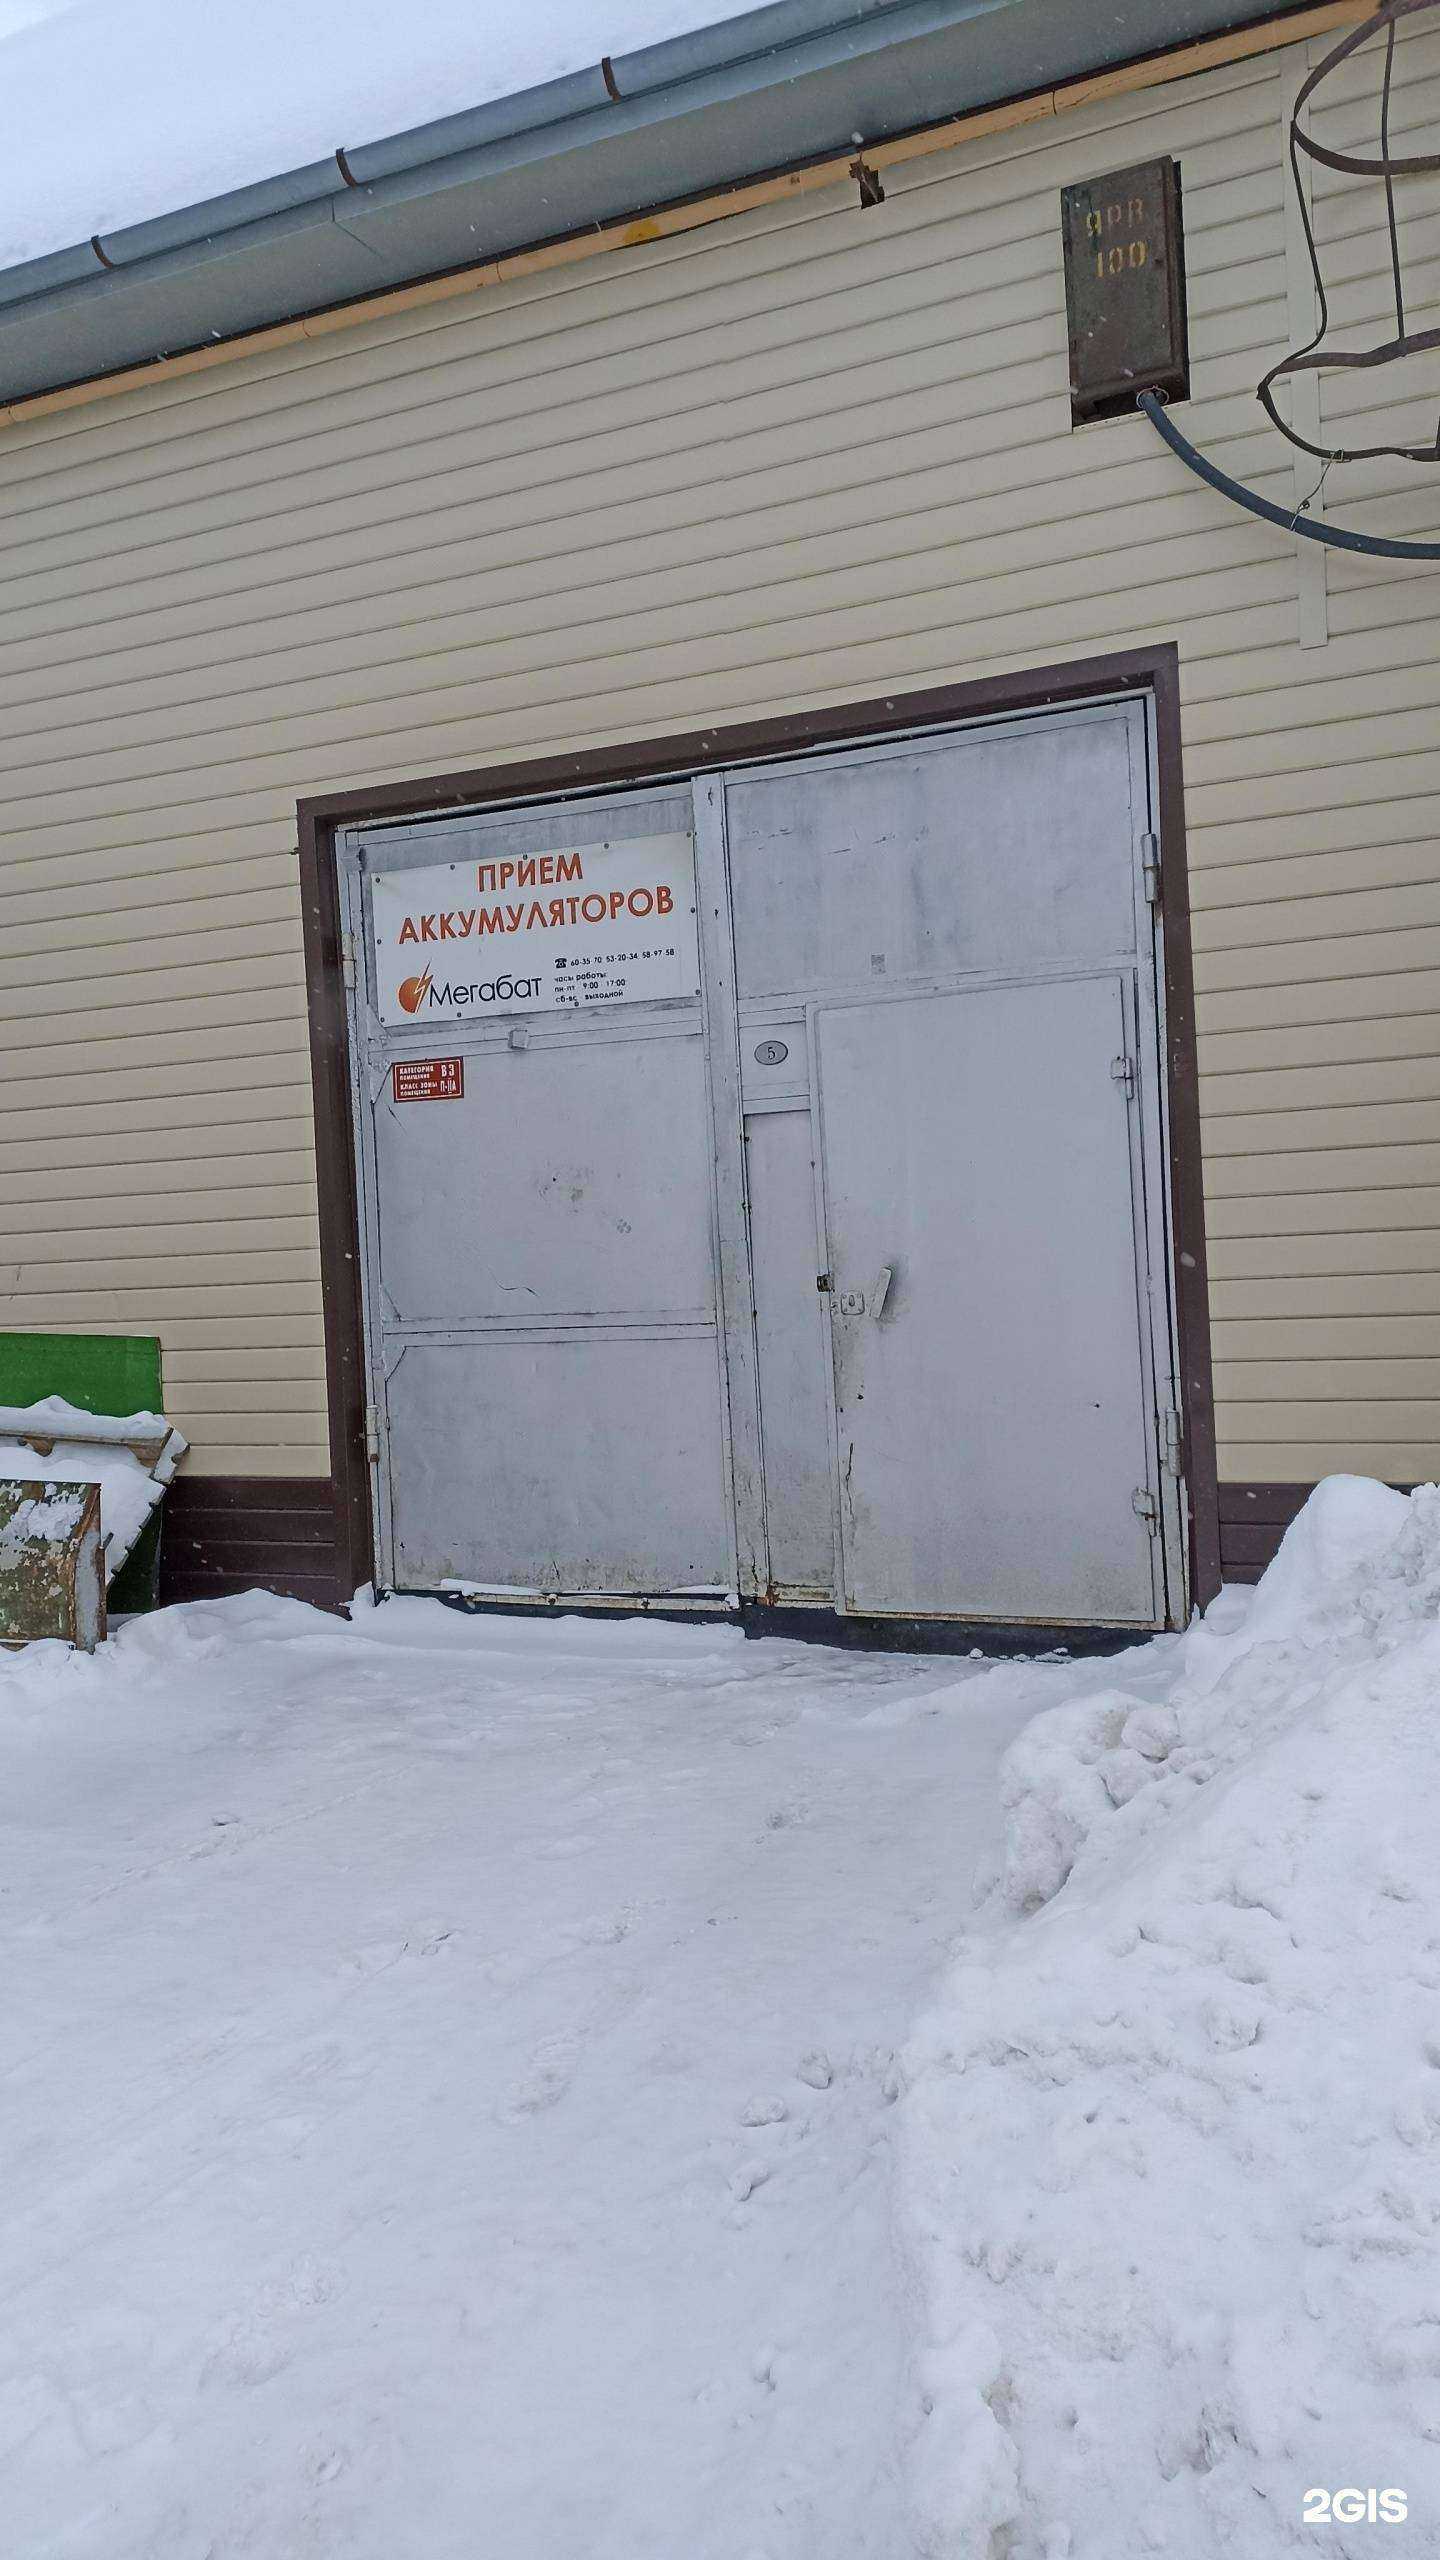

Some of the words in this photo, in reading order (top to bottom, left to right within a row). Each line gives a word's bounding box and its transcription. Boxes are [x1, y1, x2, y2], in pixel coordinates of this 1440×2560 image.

[1097, 240, 1148, 278] 100
[478, 853, 584, 892] ПРИЕМ
[399, 886, 674, 944] АККУМУЛЯТОРОВ
[429, 974, 542, 1007] Мегабат
[584, 988, 624, 1000] выходной
[767, 1046, 776, 1060] 5
